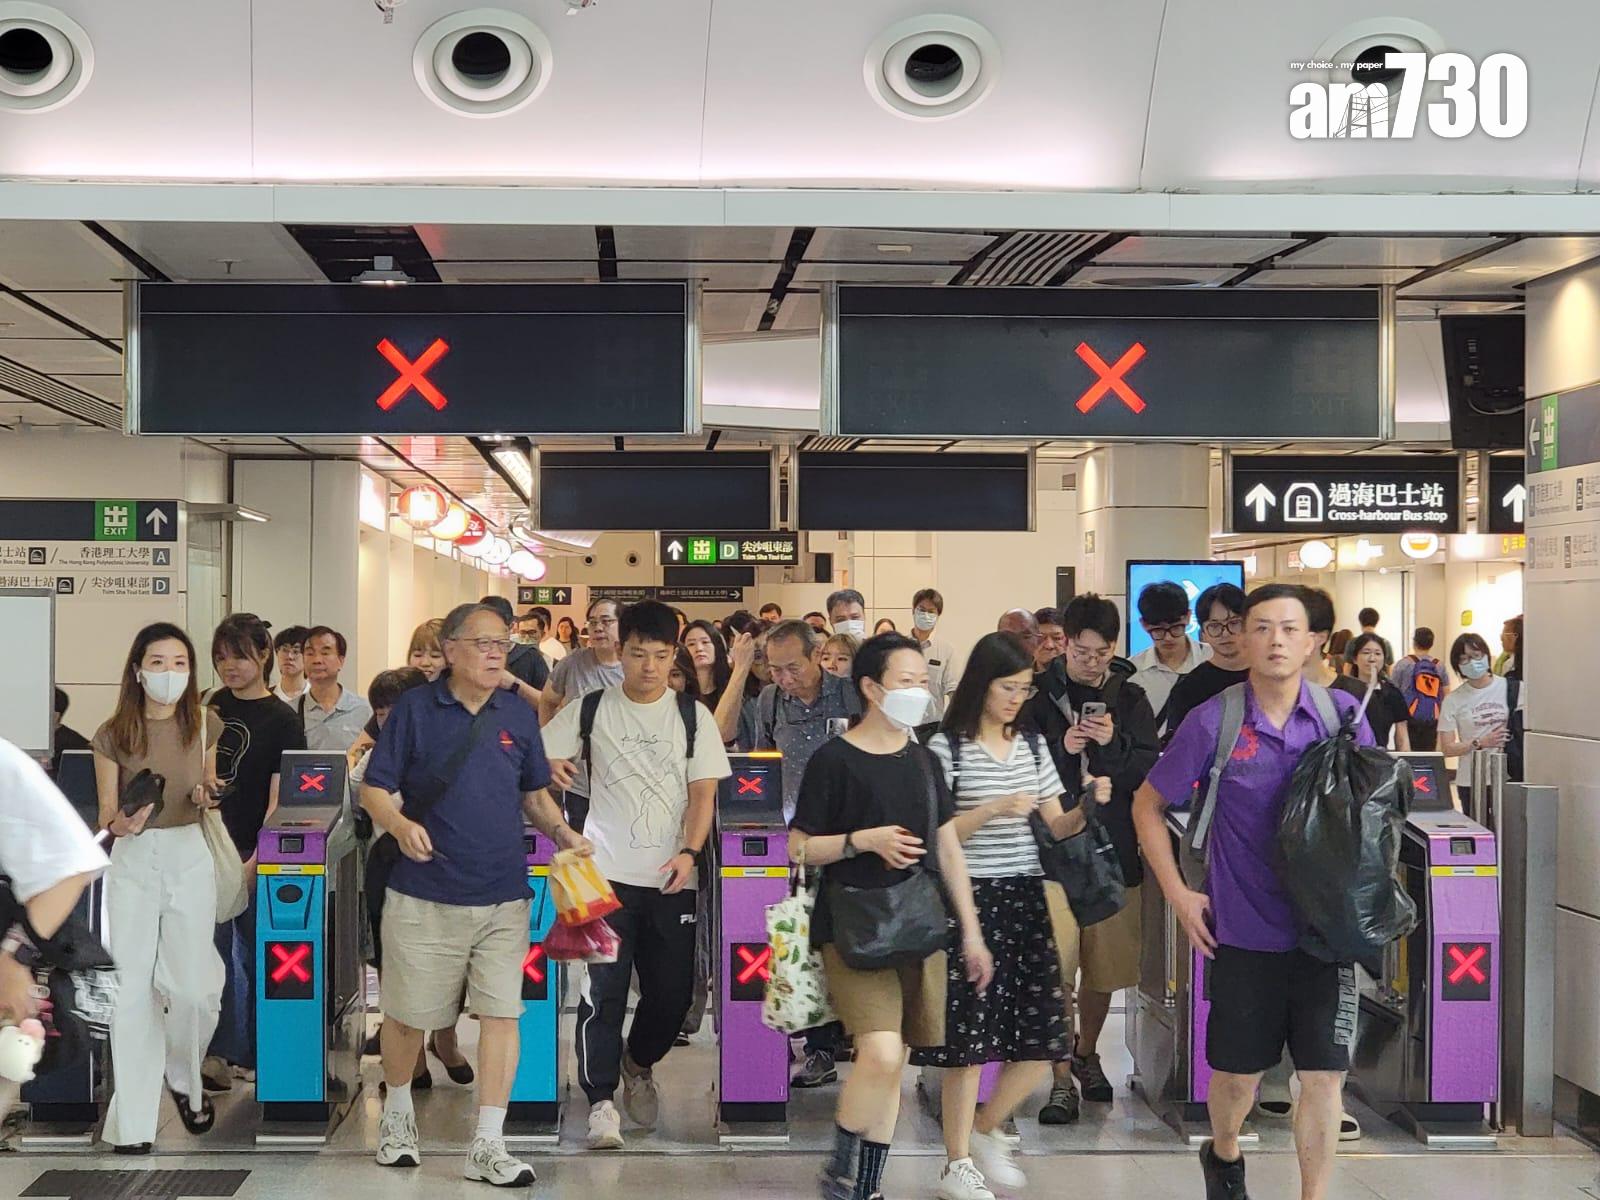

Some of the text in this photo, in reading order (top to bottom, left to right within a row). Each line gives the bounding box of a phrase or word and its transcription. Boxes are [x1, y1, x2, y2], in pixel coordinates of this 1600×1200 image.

[1328, 482, 1445, 507] 過海巴士站
[1327, 509, 1448, 523] Cross-harbour Bus stop
[103, 527, 128, 536] EXIT
[80, 546, 150, 559] 香港理工大學
[156, 551, 167, 563] A
[723, 544, 735, 557] D
[742, 541, 794, 553] 尖沙咀東部
[92, 576, 150, 588] 尖沙咀東部
[156, 580, 166, 592] D
